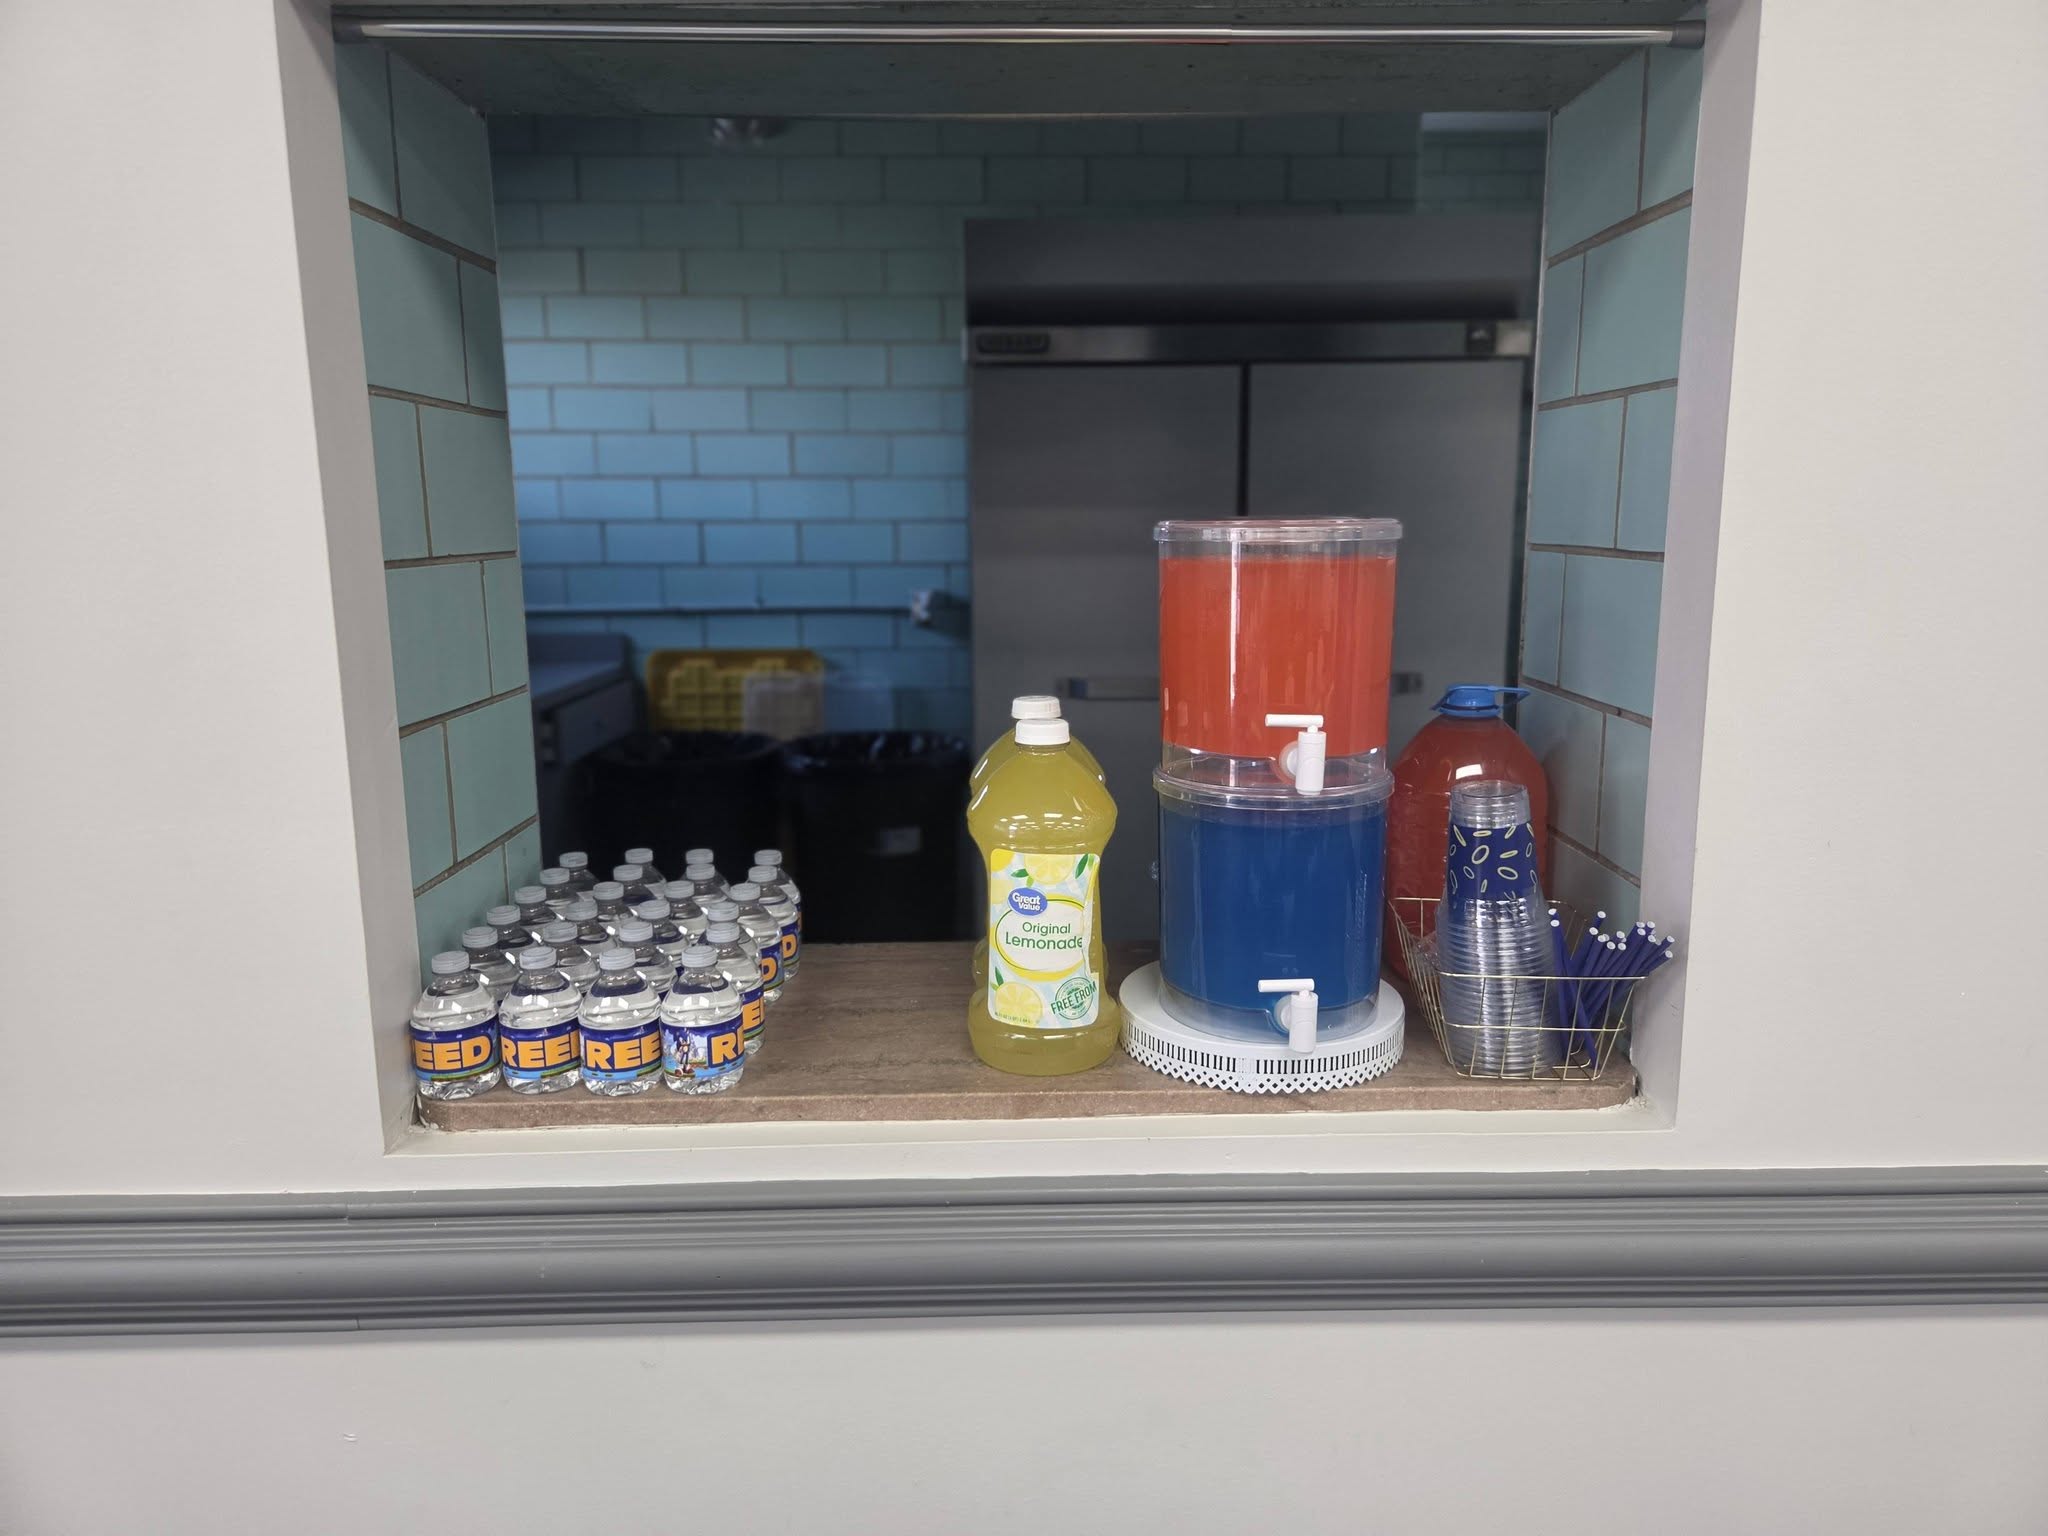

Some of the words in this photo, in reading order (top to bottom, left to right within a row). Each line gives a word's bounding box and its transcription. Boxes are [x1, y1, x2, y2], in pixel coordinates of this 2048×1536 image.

[1012, 892, 1041, 905] Great
[1019, 902, 1041, 911] Value
[1022, 921, 1071, 936] Original
[1005, 931, 1083, 950] Lemonade
[1050, 995, 1074, 1015] FREE
[1074, 981, 1097, 1004] FROM
[414, 1035, 491, 1070] EED
